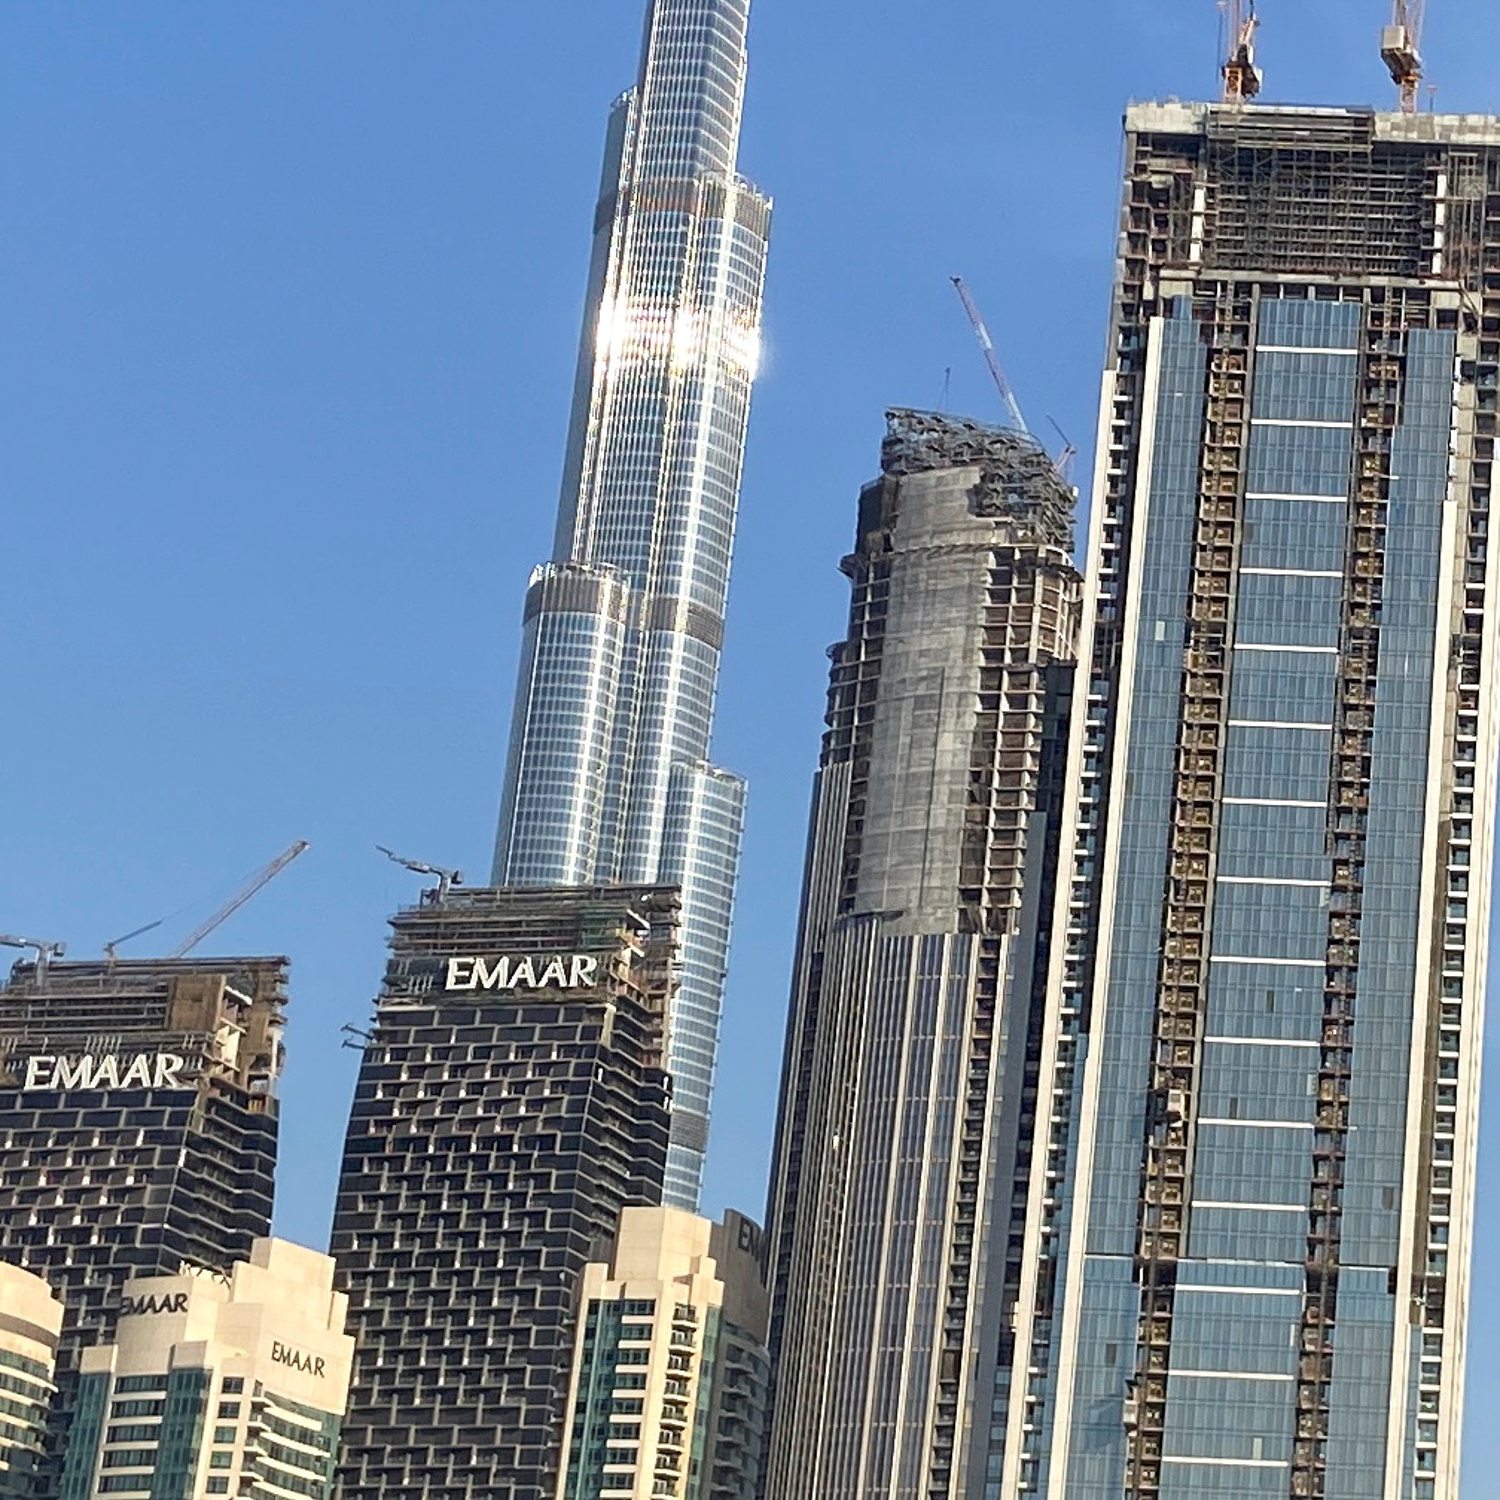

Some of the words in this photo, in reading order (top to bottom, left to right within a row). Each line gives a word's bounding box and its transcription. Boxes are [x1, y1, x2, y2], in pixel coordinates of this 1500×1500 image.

[445, 955, 598, 990] EMAAR
[23, 1053, 184, 1090] EMAAR
[271, 1340, 325, 1378] EMAAR
